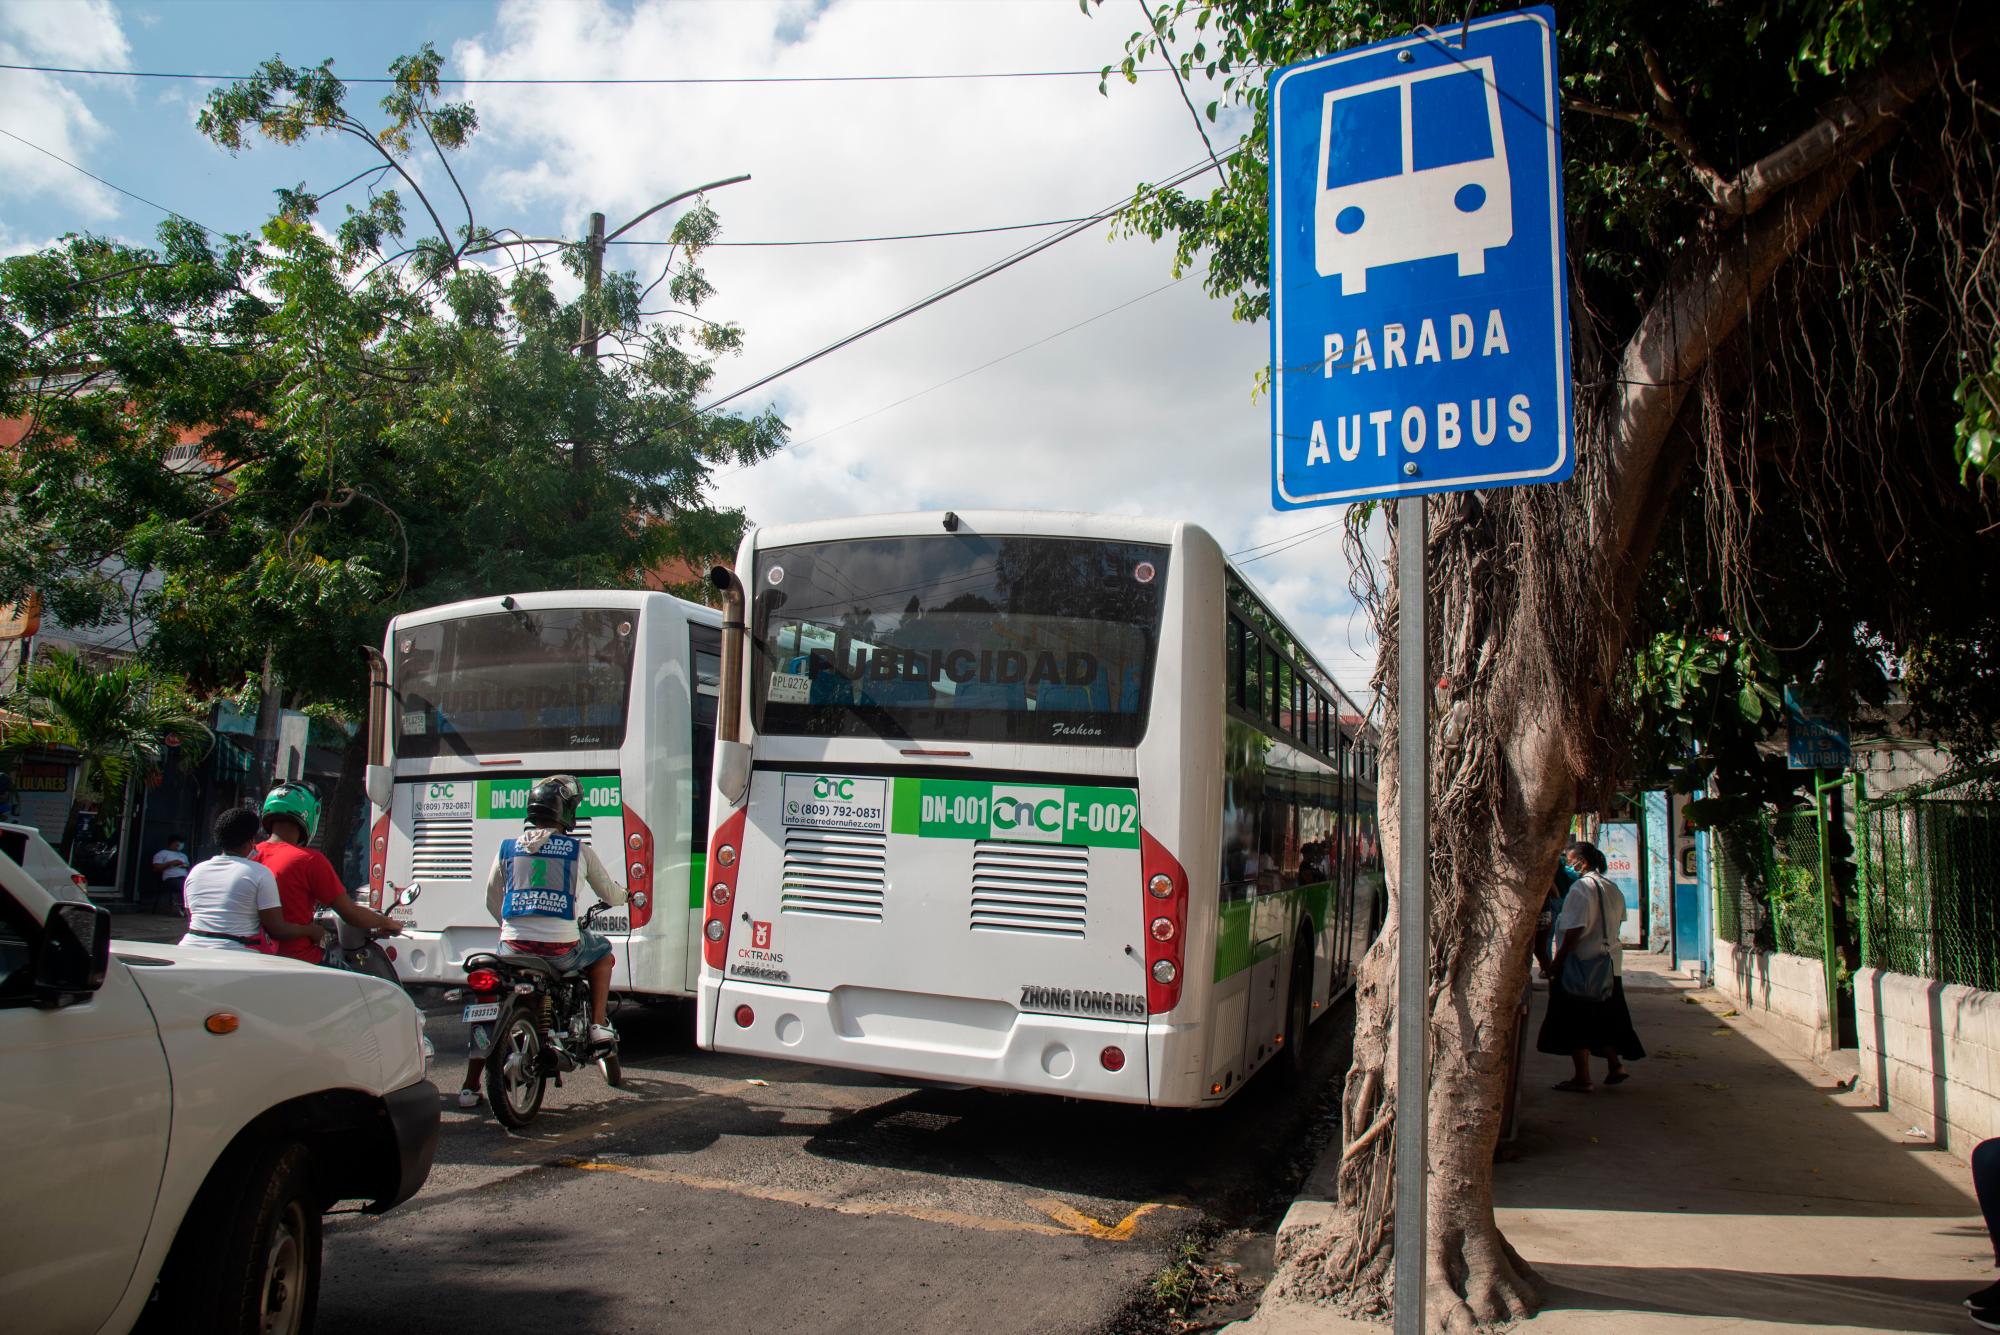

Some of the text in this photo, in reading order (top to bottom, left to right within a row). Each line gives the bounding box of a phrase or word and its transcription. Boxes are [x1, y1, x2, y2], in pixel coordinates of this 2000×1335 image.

[1324, 309, 1510, 379] PARADA
[1306, 394, 1532, 466] AUTOBUS
[810, 648, 1097, 685] PUBLICIDAD
[1052, 722, 1102, 737] Fashion
[569, 734, 600, 745] Fashion
[1795, 752, 1846, 765] AUTOBUS
[577, 787, 620, 808] -005
[801, 803, 881, 819] (809) 792-0831
[922, 795, 989, 825] DN-001
[1067, 801, 1137, 834] F-002
[531, 859, 548, 887] 2
[511, 898, 568, 909] NOCTURNO
[512, 890, 568, 903] PARADA
[526, 904, 563, 913] MADRINA
[609, 915, 628, 931] BUS
[1114, 992, 1145, 1017] BUS
